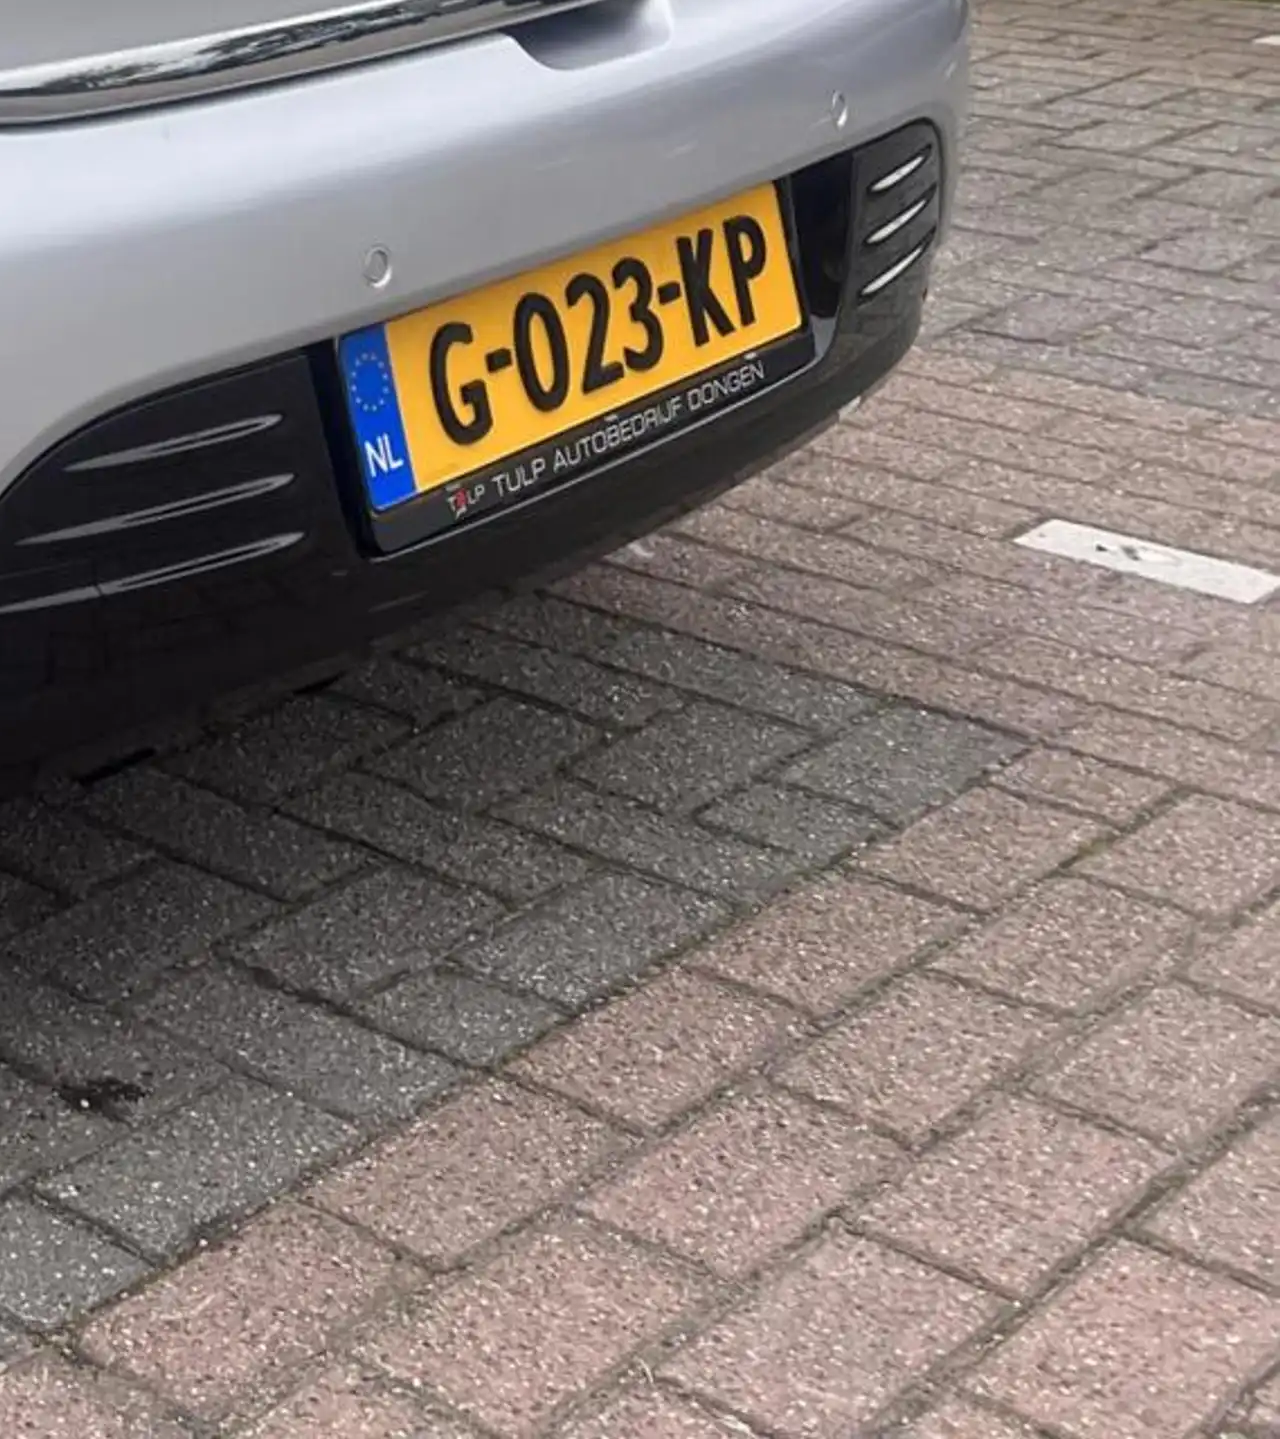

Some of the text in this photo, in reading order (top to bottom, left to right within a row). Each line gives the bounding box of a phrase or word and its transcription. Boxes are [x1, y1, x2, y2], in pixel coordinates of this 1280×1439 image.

[429, 215, 767, 445] G-023-KP
[364, 433, 404, 478] NL
[491, 457, 547, 498] TULP
[552, 395, 683, 474] AUTOBEDRIJF
[686, 359, 765, 411] DONGEN
